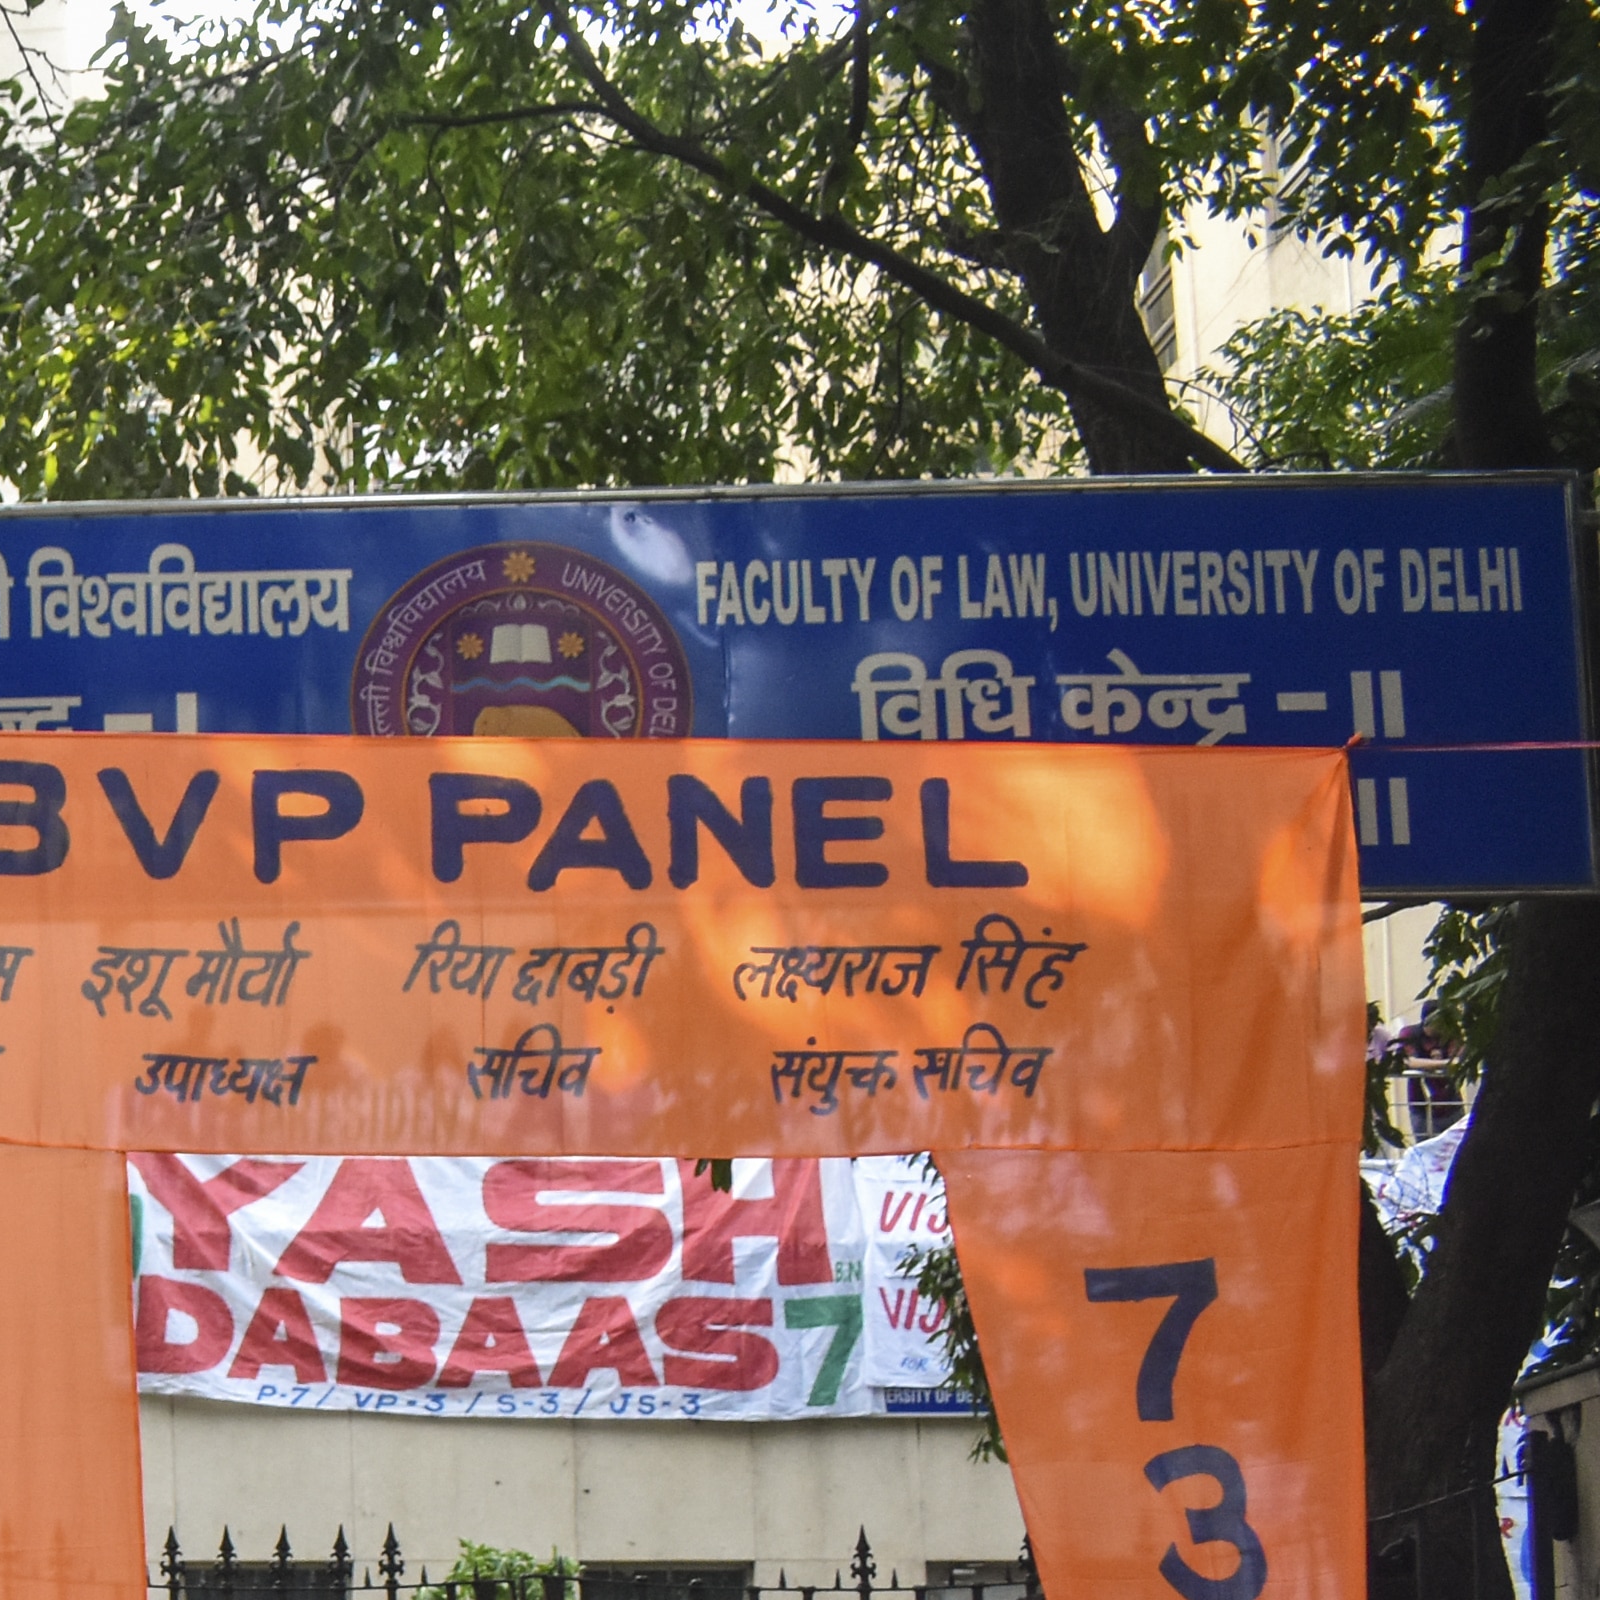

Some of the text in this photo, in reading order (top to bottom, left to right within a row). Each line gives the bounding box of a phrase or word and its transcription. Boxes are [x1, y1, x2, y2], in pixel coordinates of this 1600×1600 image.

[25, 542, 353, 641] विश्वविद्यालय
[562, 562, 668, 656] UNIVERSITY
[648, 662, 677, 691] OF
[696, 547, 1521, 633] FACULTY OF LAW, UNIVERSITY OF DELHI
[851, 650, 1033, 741] विधि
[428, 772, 1029, 890] PANEL
[81, 945, 189, 1021] इशू
[402, 919, 514, 1000] रिया
[956, 913, 1088, 1009] सिंह
[135, 1053, 317, 1107] उपाध्यक्ष
[467, 1023, 602, 1099] सचिव
[912, 1022, 1054, 1100] सचिव
[127, 1152, 832, 1286] YASH
[137, 1275, 863, 1406] DABAAS 7
[1085, 1258, 1216, 1421] 7
